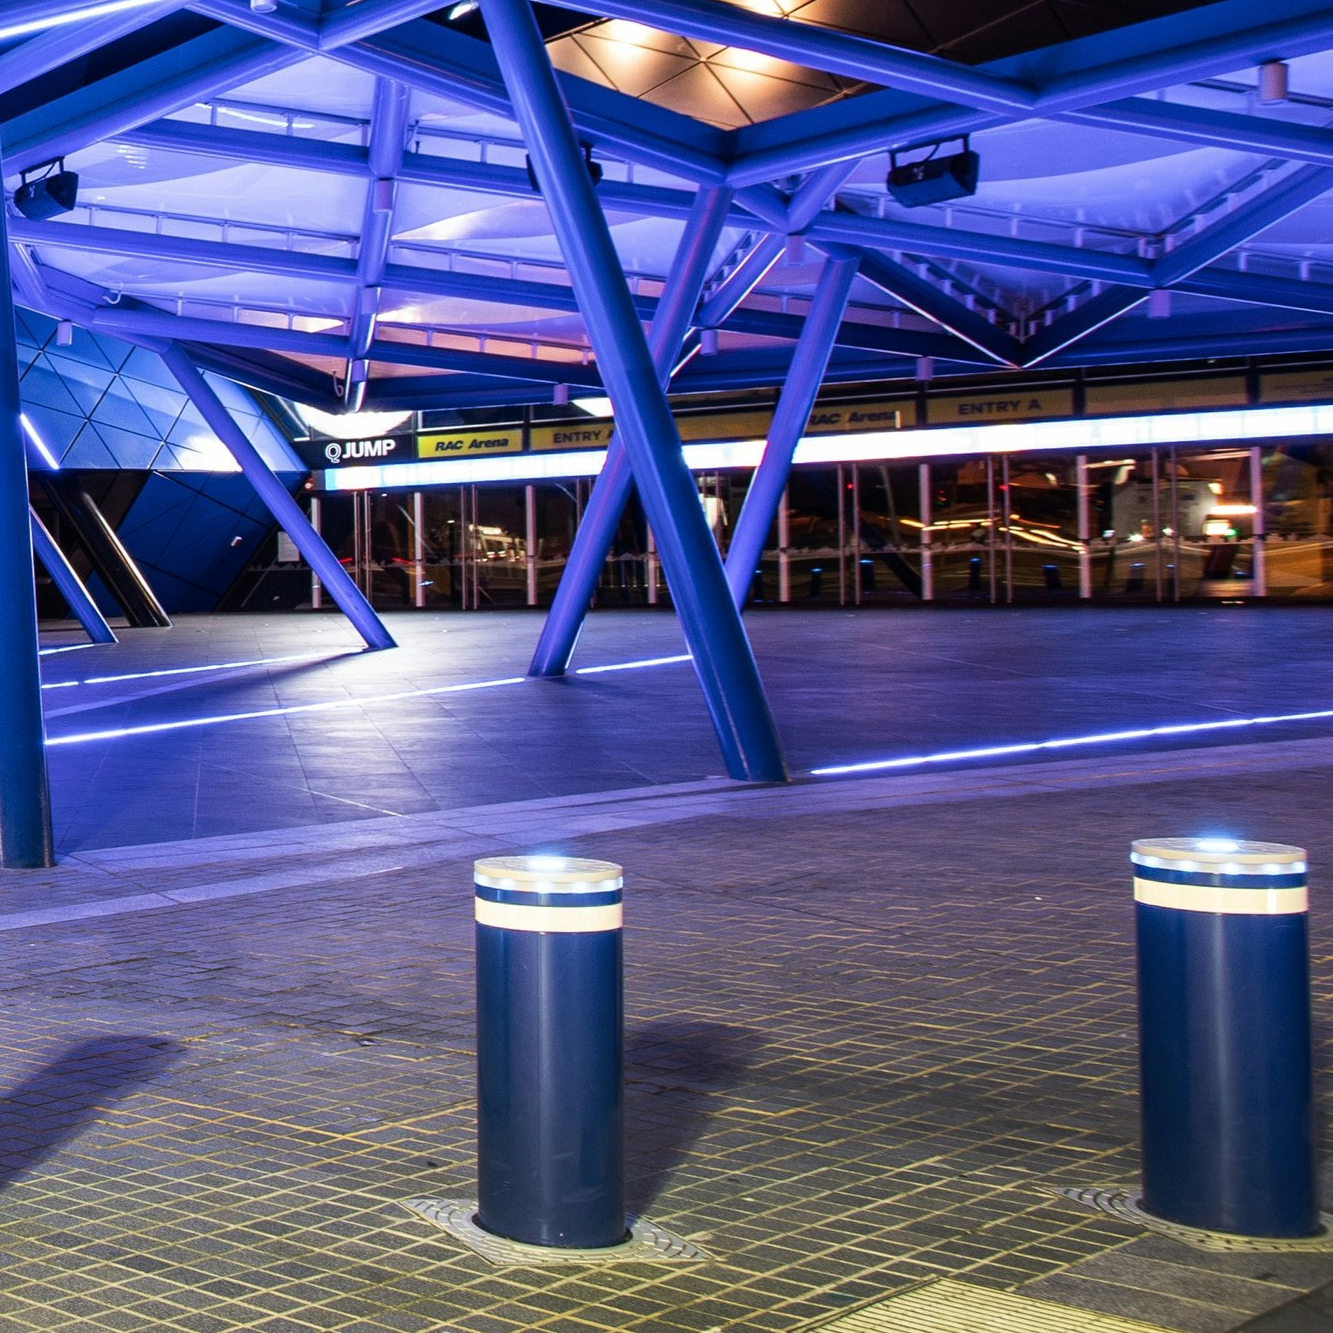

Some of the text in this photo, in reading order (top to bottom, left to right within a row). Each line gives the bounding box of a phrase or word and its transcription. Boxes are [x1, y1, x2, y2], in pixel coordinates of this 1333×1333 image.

[957, 399, 1042, 415] ENTRY A
[553, 430, 602, 443] ENTRY
[434, 438, 509, 452] RAC Arena
